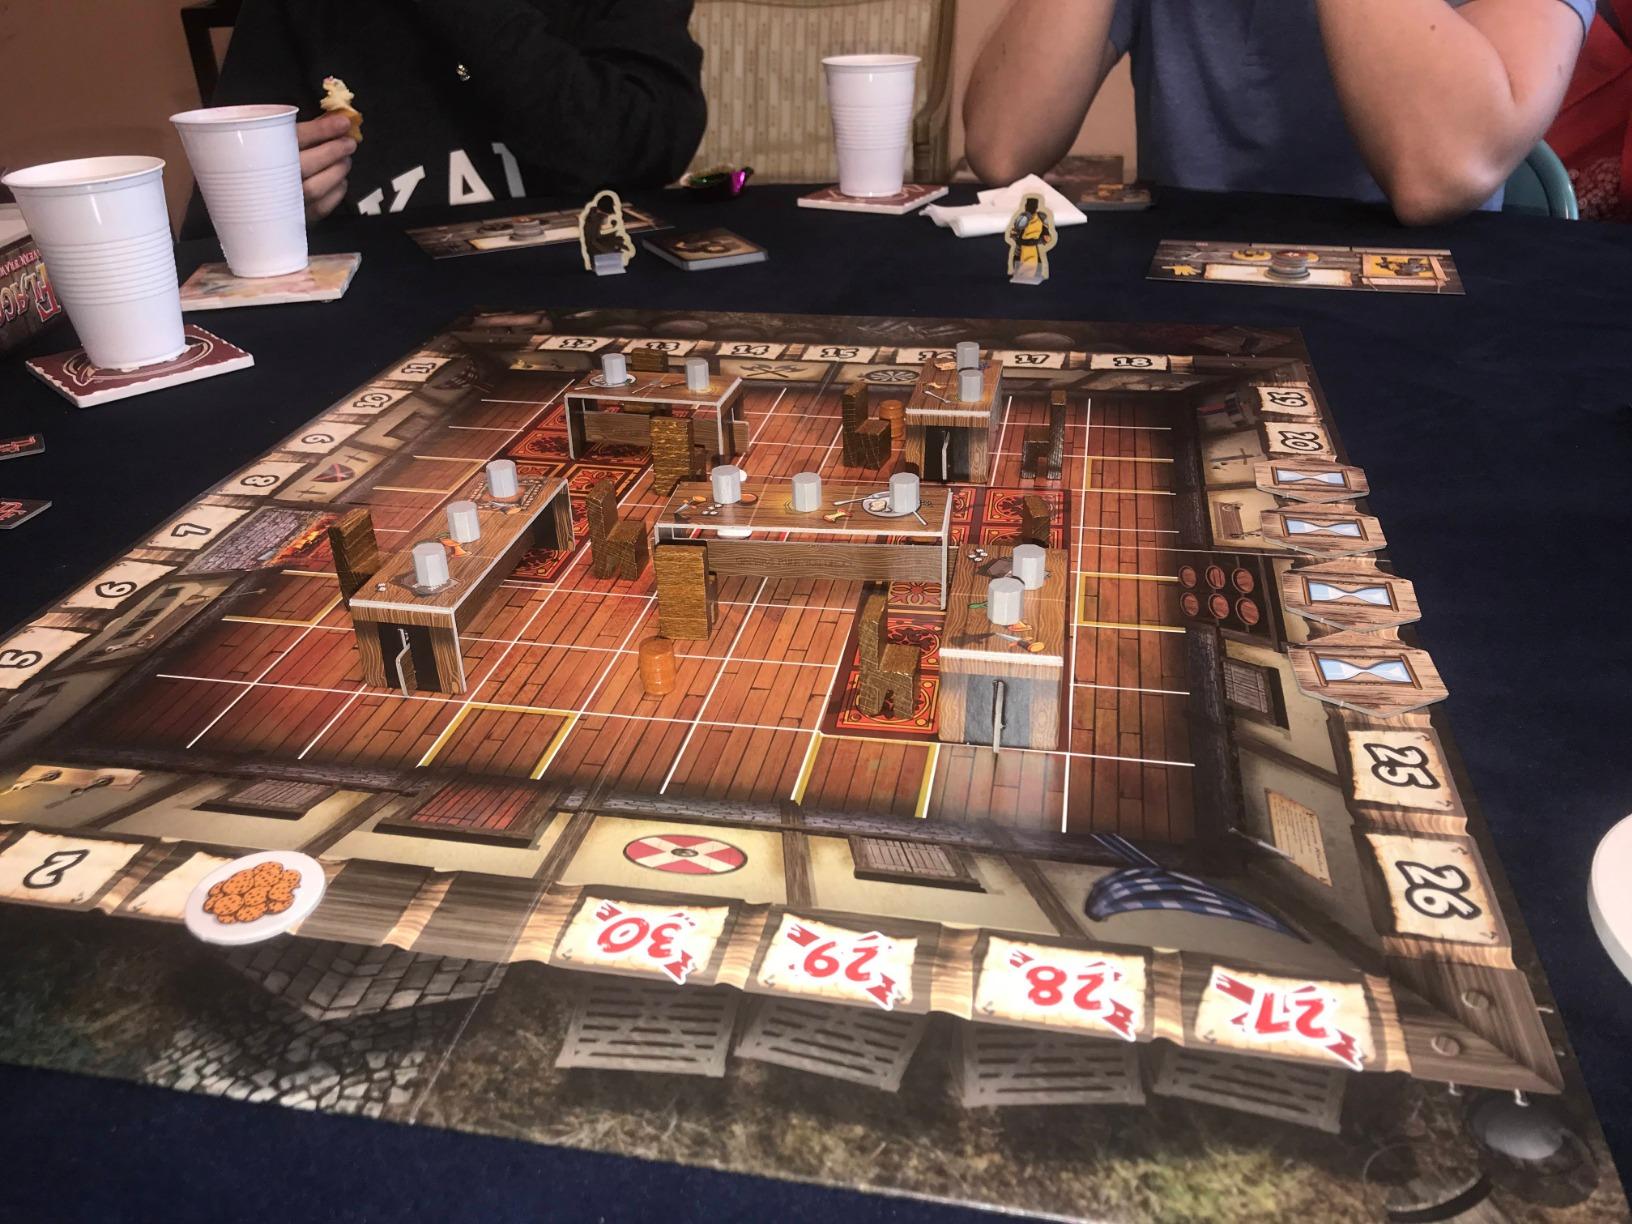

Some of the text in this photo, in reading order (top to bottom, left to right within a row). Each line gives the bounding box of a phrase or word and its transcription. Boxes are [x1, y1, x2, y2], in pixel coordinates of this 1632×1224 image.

[19, 248, 42, 267] VERN
[0, 262, 62, 326] FLAG
[560, 338, 597, 350] 12
[645, 341, 681, 352] 13
[732, 344, 770, 356] 14
[821, 347, 859, 360] 15
[1014, 353, 1051, 366] 17
[1112, 356, 1153, 368] 18
[401, 362, 437, 375] 11
[352, 392, 394, 409] 10
[1267, 391, 1307, 407] 19
[302, 433, 335, 446] 9
[1278, 430, 1323, 451] 20
[240, 473, 281, 489] 8
[171, 522, 213, 539] 7
[96, 580, 138, 599] 6
[0, 649, 43, 669] 5
[1363, 742, 1441, 790] 25
[23, 849, 90, 889] 2
[1395, 860, 1482, 920] 26
[596, 916, 683, 959] 30
[802, 940, 880, 983] 29
[1025, 965, 1105, 1011] 28
[1254, 990, 1329, 1039] 27
